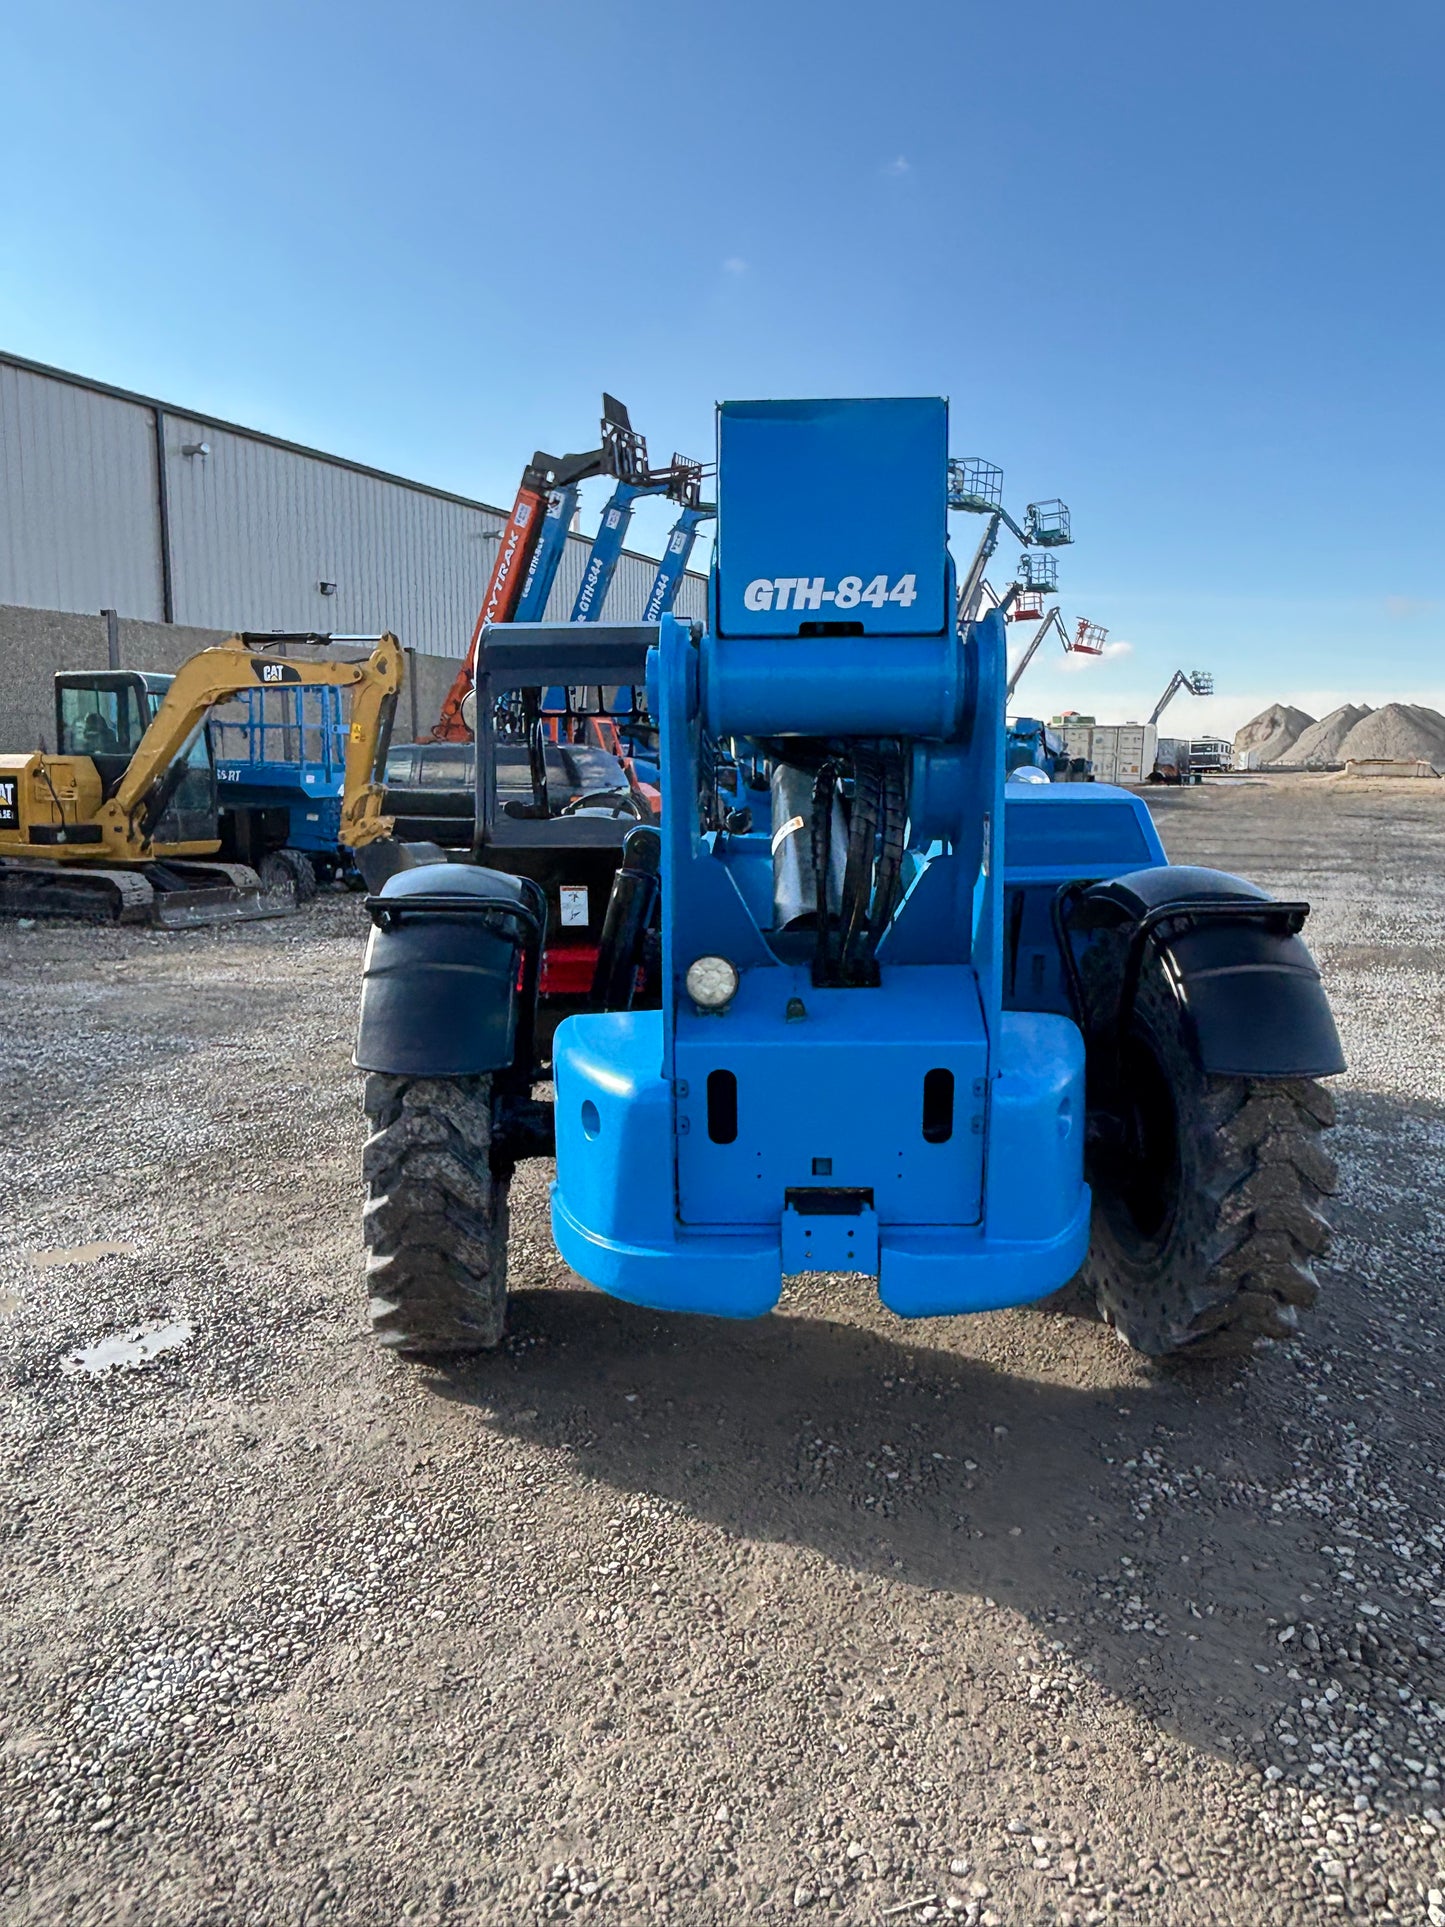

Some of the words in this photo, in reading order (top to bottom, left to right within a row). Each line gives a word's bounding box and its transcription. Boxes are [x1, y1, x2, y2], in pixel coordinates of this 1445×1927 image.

[483, 529, 519, 625] KYTRAK
[578, 557, 603, 612] GTH-844
[647, 574, 669, 621] GTH-844
[745, 575, 917, 611] GTH-844
[263, 665, 284, 682] CAT
[0, 783, 14, 805] AT
